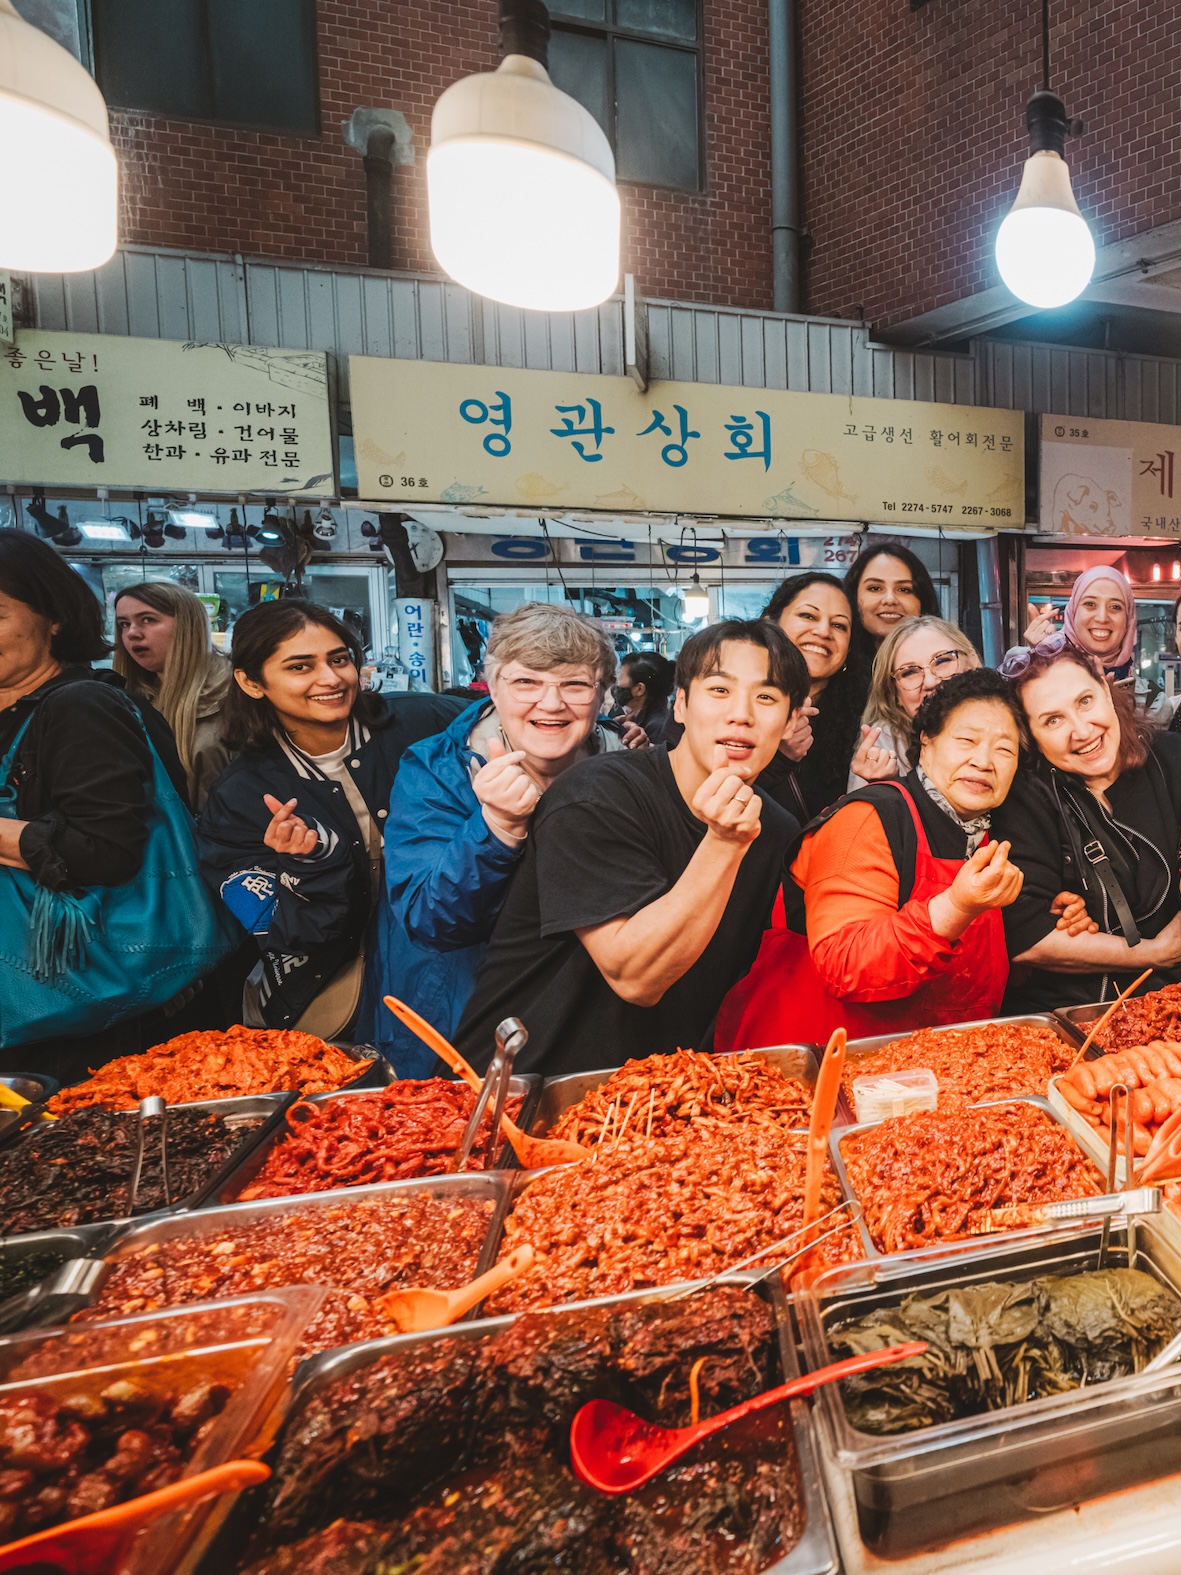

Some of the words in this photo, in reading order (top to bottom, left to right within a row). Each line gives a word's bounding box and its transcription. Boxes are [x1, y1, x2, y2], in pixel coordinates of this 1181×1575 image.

[3, 347, 99, 373] 좋은날!
[17, 385, 105, 464] 백
[459, 390, 771, 473] 영관상회
[843, 424, 913, 444] 고급생선
[259, 450, 300, 468] 전문
[882, 501, 896, 511] Tel
[901, 502, 953, 514] 2274-5747
[961, 505, 1012, 517] 2267-3068
[1140, 516, 1181, 533] 국내산
